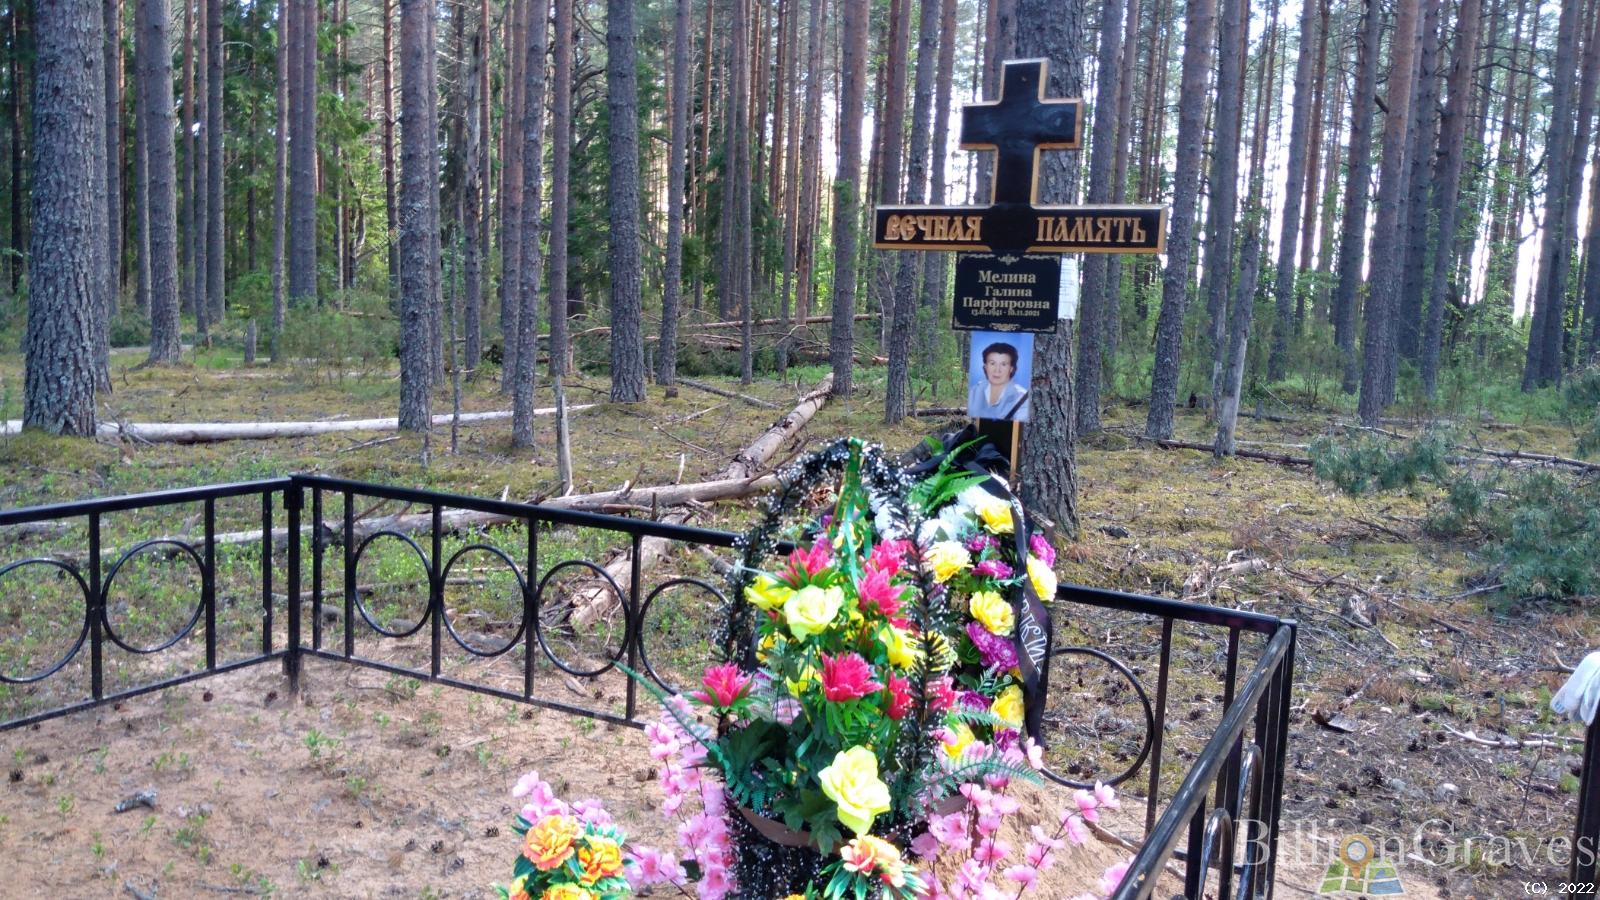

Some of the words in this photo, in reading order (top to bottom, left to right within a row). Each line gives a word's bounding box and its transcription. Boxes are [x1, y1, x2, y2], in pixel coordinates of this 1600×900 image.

[1036, 216, 1146, 243] ПАМЯТЬ
[978, 270, 1036, 284] Мелина
[985, 286, 1032, 297] Галина
[962, 297, 1050, 312] Парфировна
